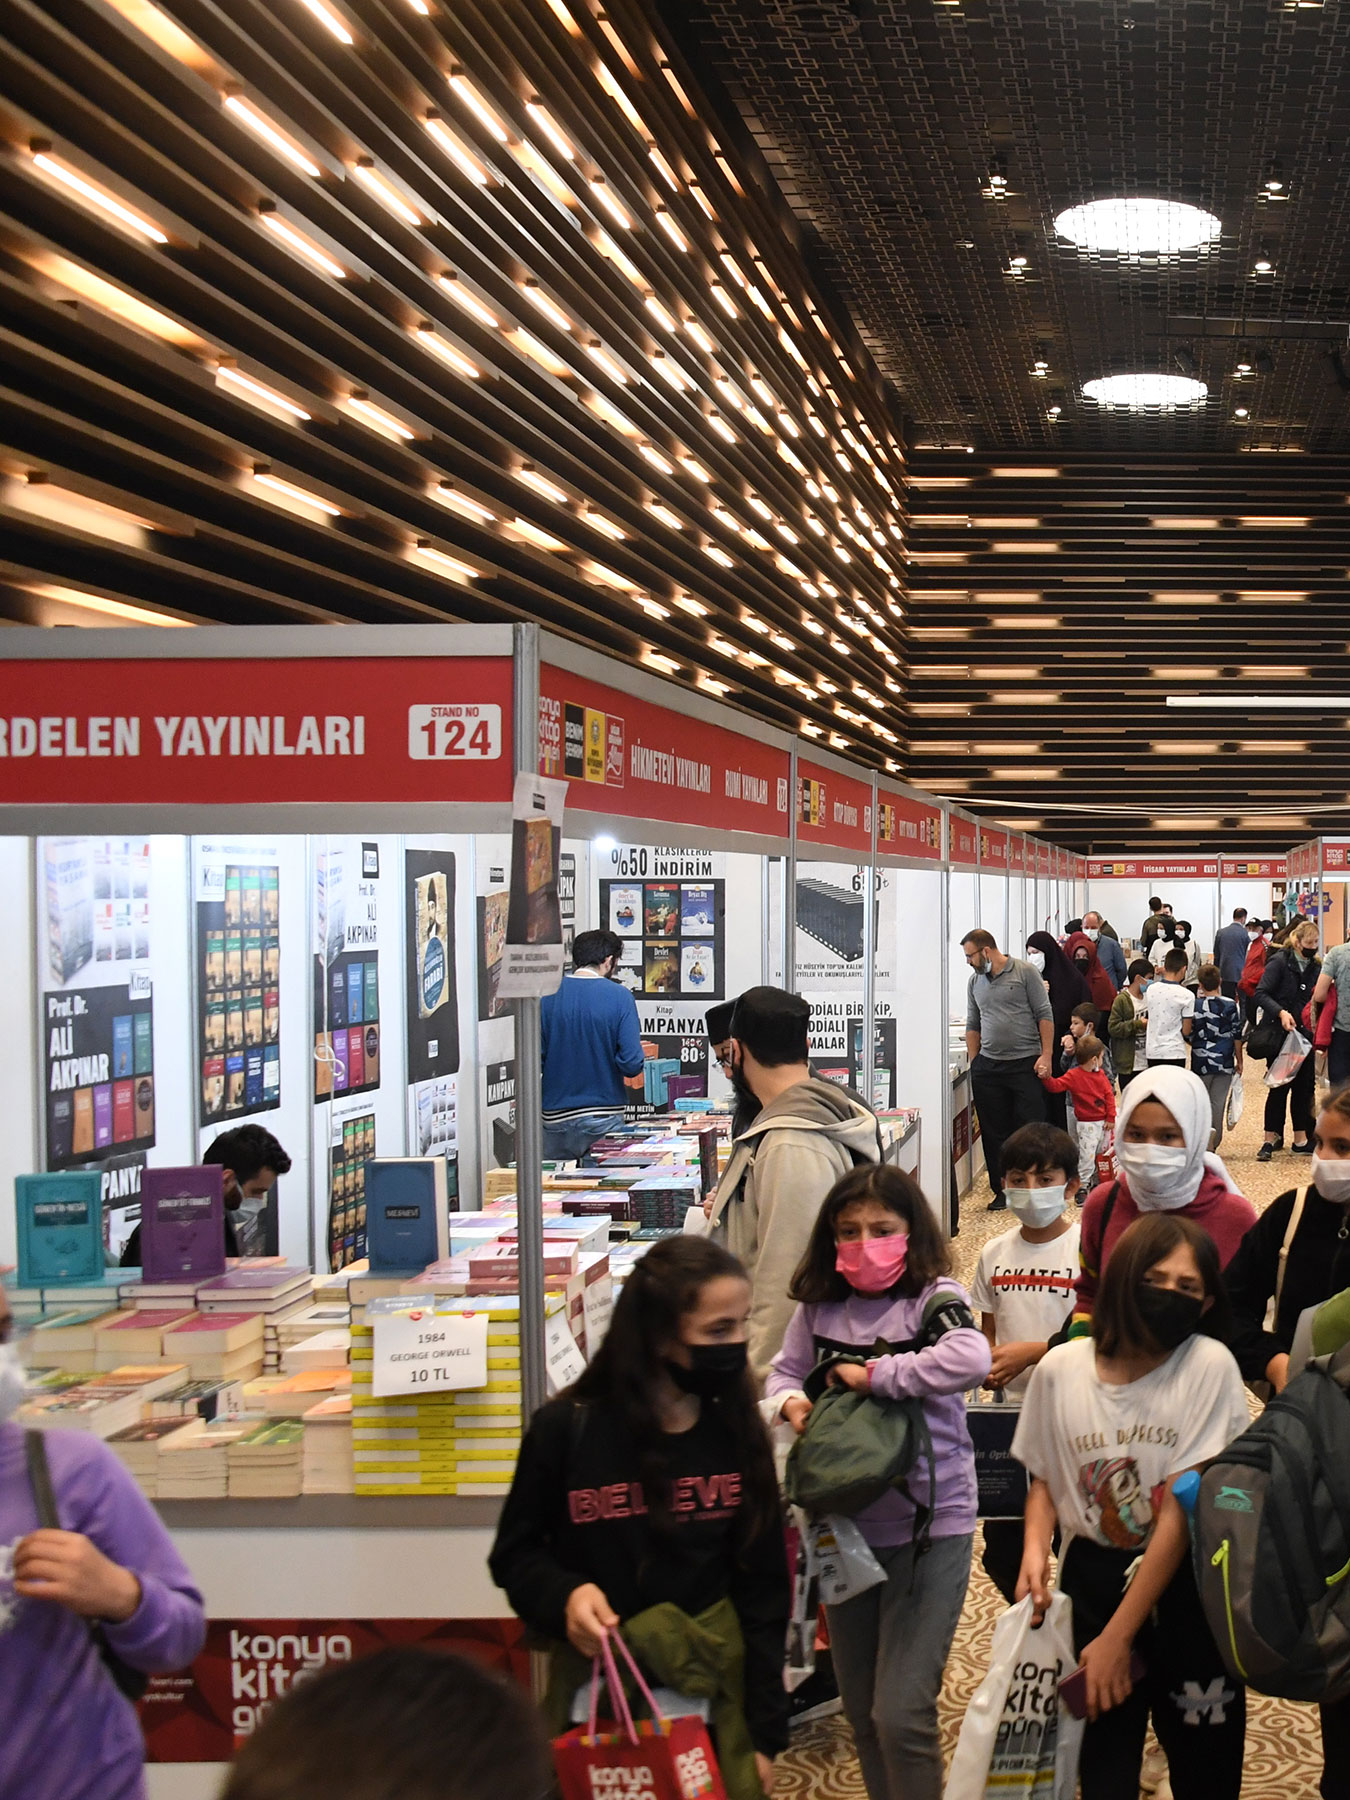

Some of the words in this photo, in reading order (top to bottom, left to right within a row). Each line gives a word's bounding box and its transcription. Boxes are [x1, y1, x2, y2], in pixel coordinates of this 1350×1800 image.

[431, 707, 460, 717] STAND
[463, 706, 479, 717] NO
[154, 715, 364, 757] YAYINLARI
[421, 720, 491, 756] 124
[611, 848, 647, 876] %50
[654, 858, 712, 876] İNDİRİM
[808, 1001, 842, 1016] DDİALI
[874, 1001, 892, 1018] KİP,
[640, 1019, 705, 1034] MPANYA
[808, 1017, 845, 1032] DDİALI
[50, 1018, 74, 1057] ALİ
[809, 1037, 845, 1050] MALAR
[50, 1053, 109, 1091] AKPINAR
[488, 1080, 515, 1103] KAMPANY
[418, 1332, 446, 1344] 1984
[390, 1351, 429, 1362] GEORGE
[434, 1348, 471, 1360] ORWELL
[411, 1369, 428, 1383] 10
[434, 1368, 450, 1381] TL
[229, 1629, 352, 1669] konya
